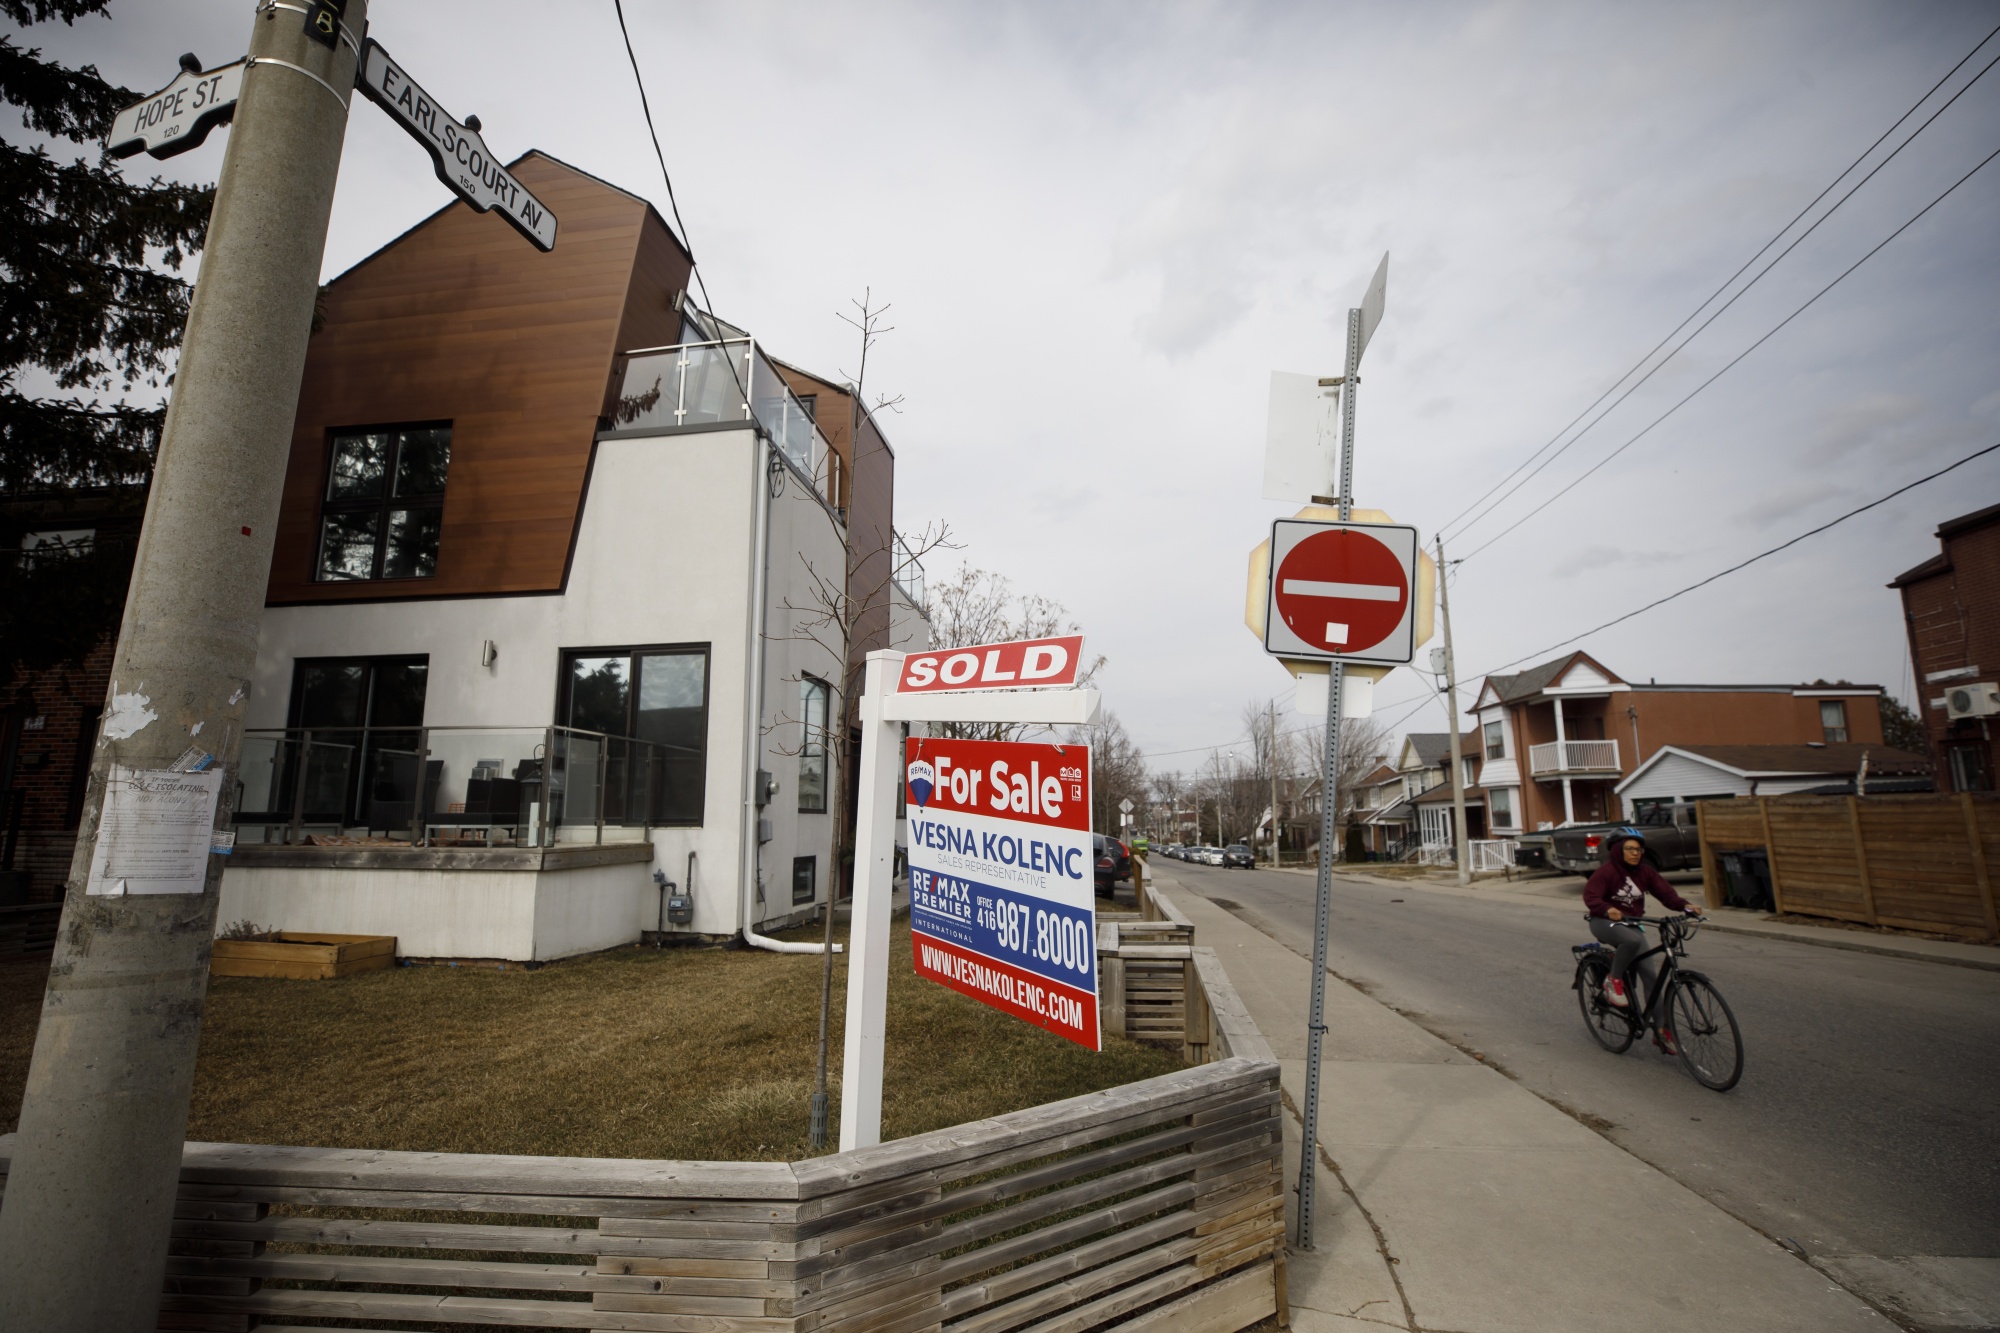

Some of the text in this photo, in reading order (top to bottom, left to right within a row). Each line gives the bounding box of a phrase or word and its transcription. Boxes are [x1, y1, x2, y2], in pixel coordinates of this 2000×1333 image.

[133, 75, 223, 133] HOPE ST.
[163, 125, 180, 140] 120
[381, 65, 543, 236] EARLSCOURT AV.
[458, 174, 476, 195] 150
[906, 644, 1068, 687] SOLD
[911, 766, 931, 777] RE/MAX
[934, 756, 1063, 818] For Sale
[911, 819, 1083, 880] VESNA KOLENC
[912, 870, 970, 904] RE/MAX
[937, 853, 1047, 889] SALES REPRESENTATIVE
[914, 890, 971, 919] PREMIER
[976, 895, 993, 910] OFFICE
[915, 918, 973, 943] INTERNATIONAL
[976, 910, 996, 931] 416
[996, 898, 1089, 974] 987.8000
[921, 943, 1083, 1031] WWW.VESNAKOLENC.COM
